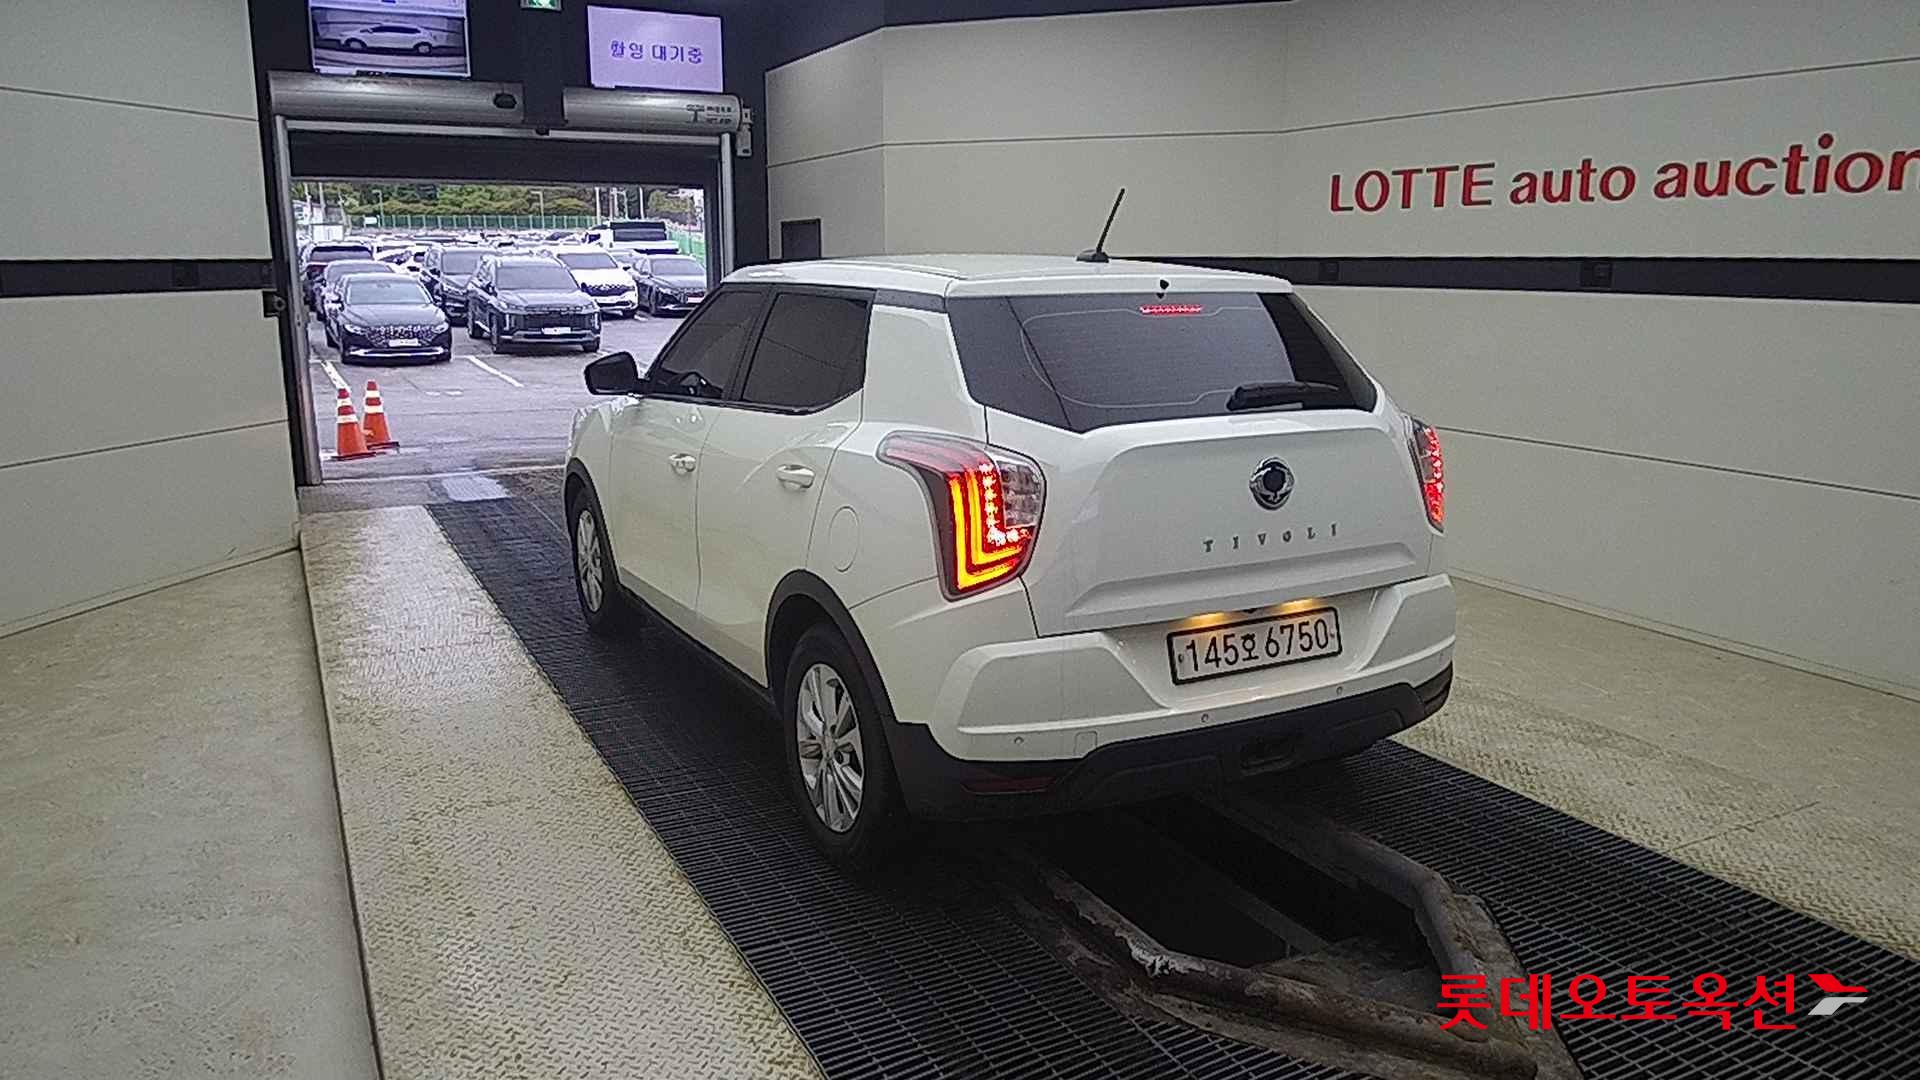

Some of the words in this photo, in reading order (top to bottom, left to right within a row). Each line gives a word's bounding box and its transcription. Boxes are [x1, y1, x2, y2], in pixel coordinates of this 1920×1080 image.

[651, 44, 702, 64] 대기중
[1330, 162, 1495, 212] LOTTE
[1509, 158, 1636, 204] auto
[1203, 523, 1337, 552] TIVOLI
